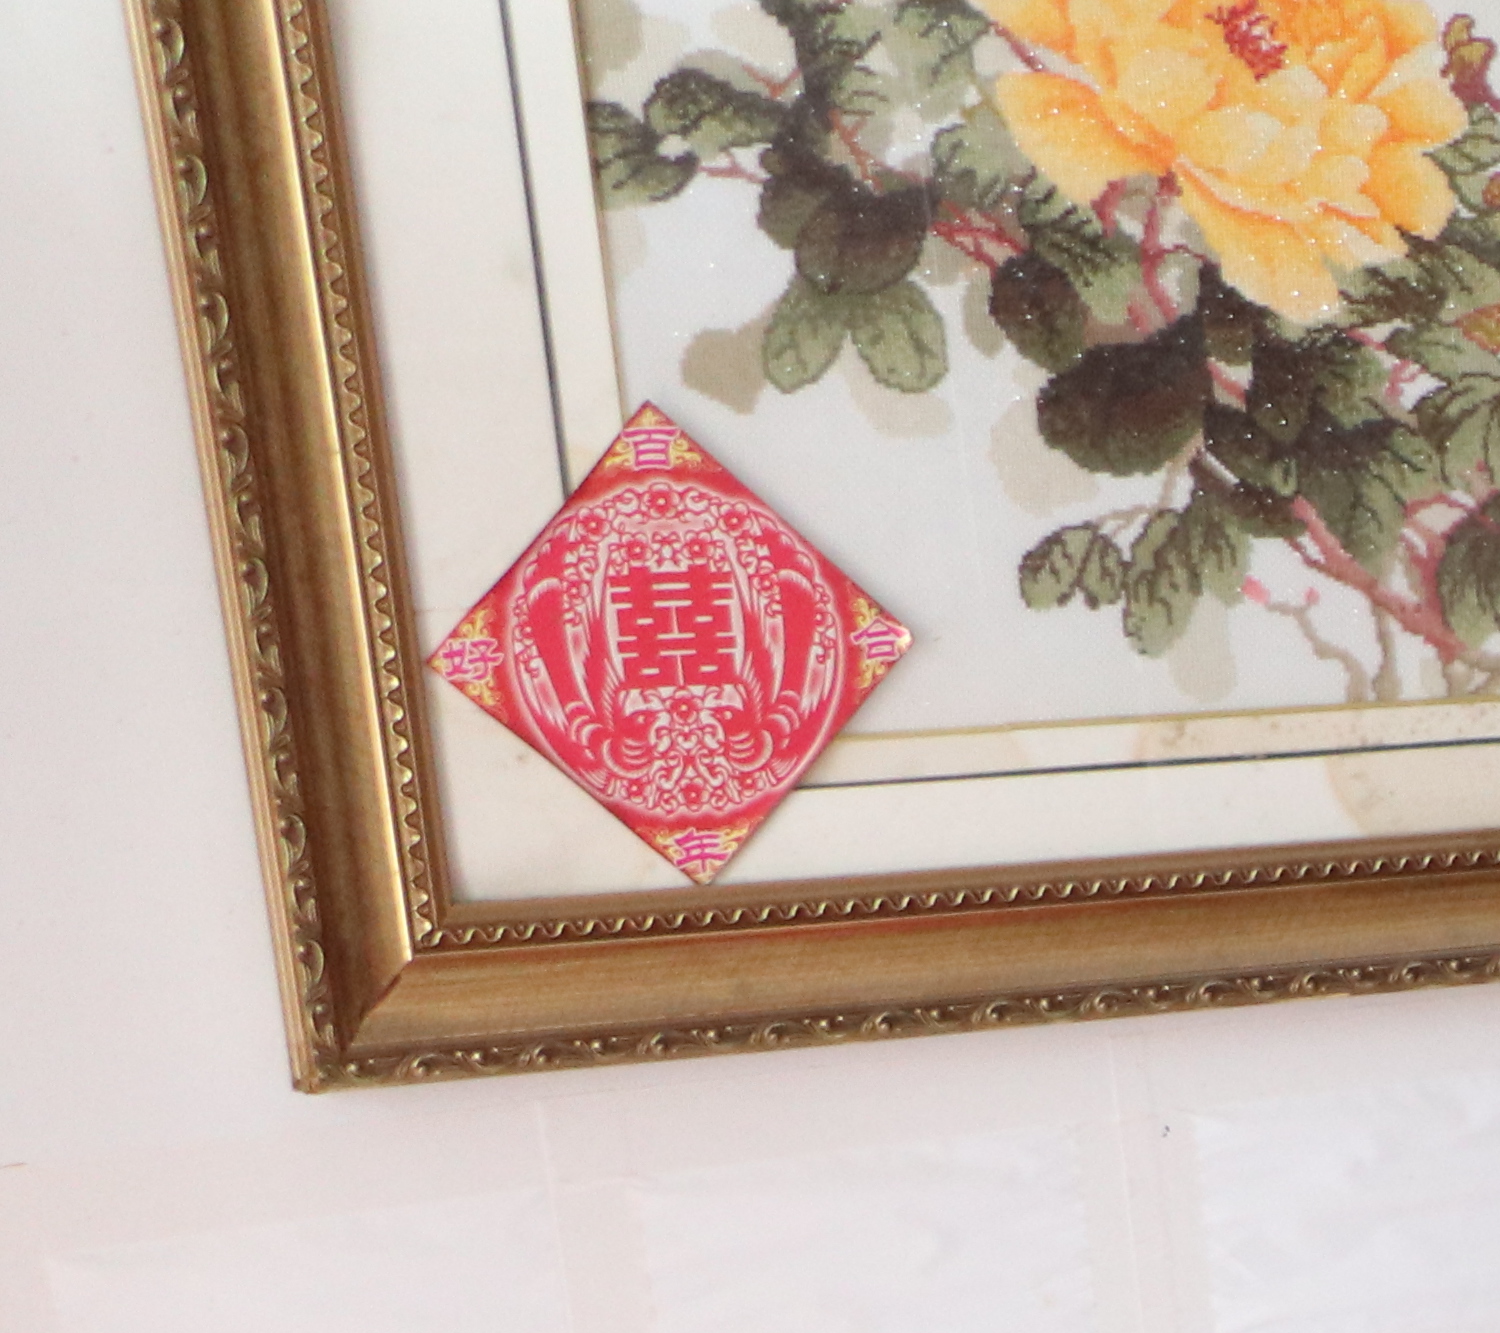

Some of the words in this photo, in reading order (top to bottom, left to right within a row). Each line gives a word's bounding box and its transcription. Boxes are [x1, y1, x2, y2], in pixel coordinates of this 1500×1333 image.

[622, 426, 679, 470] 百
[443, 637, 504, 682] 好
[852, 620, 907, 662] 合
[674, 832, 730, 872] 年
